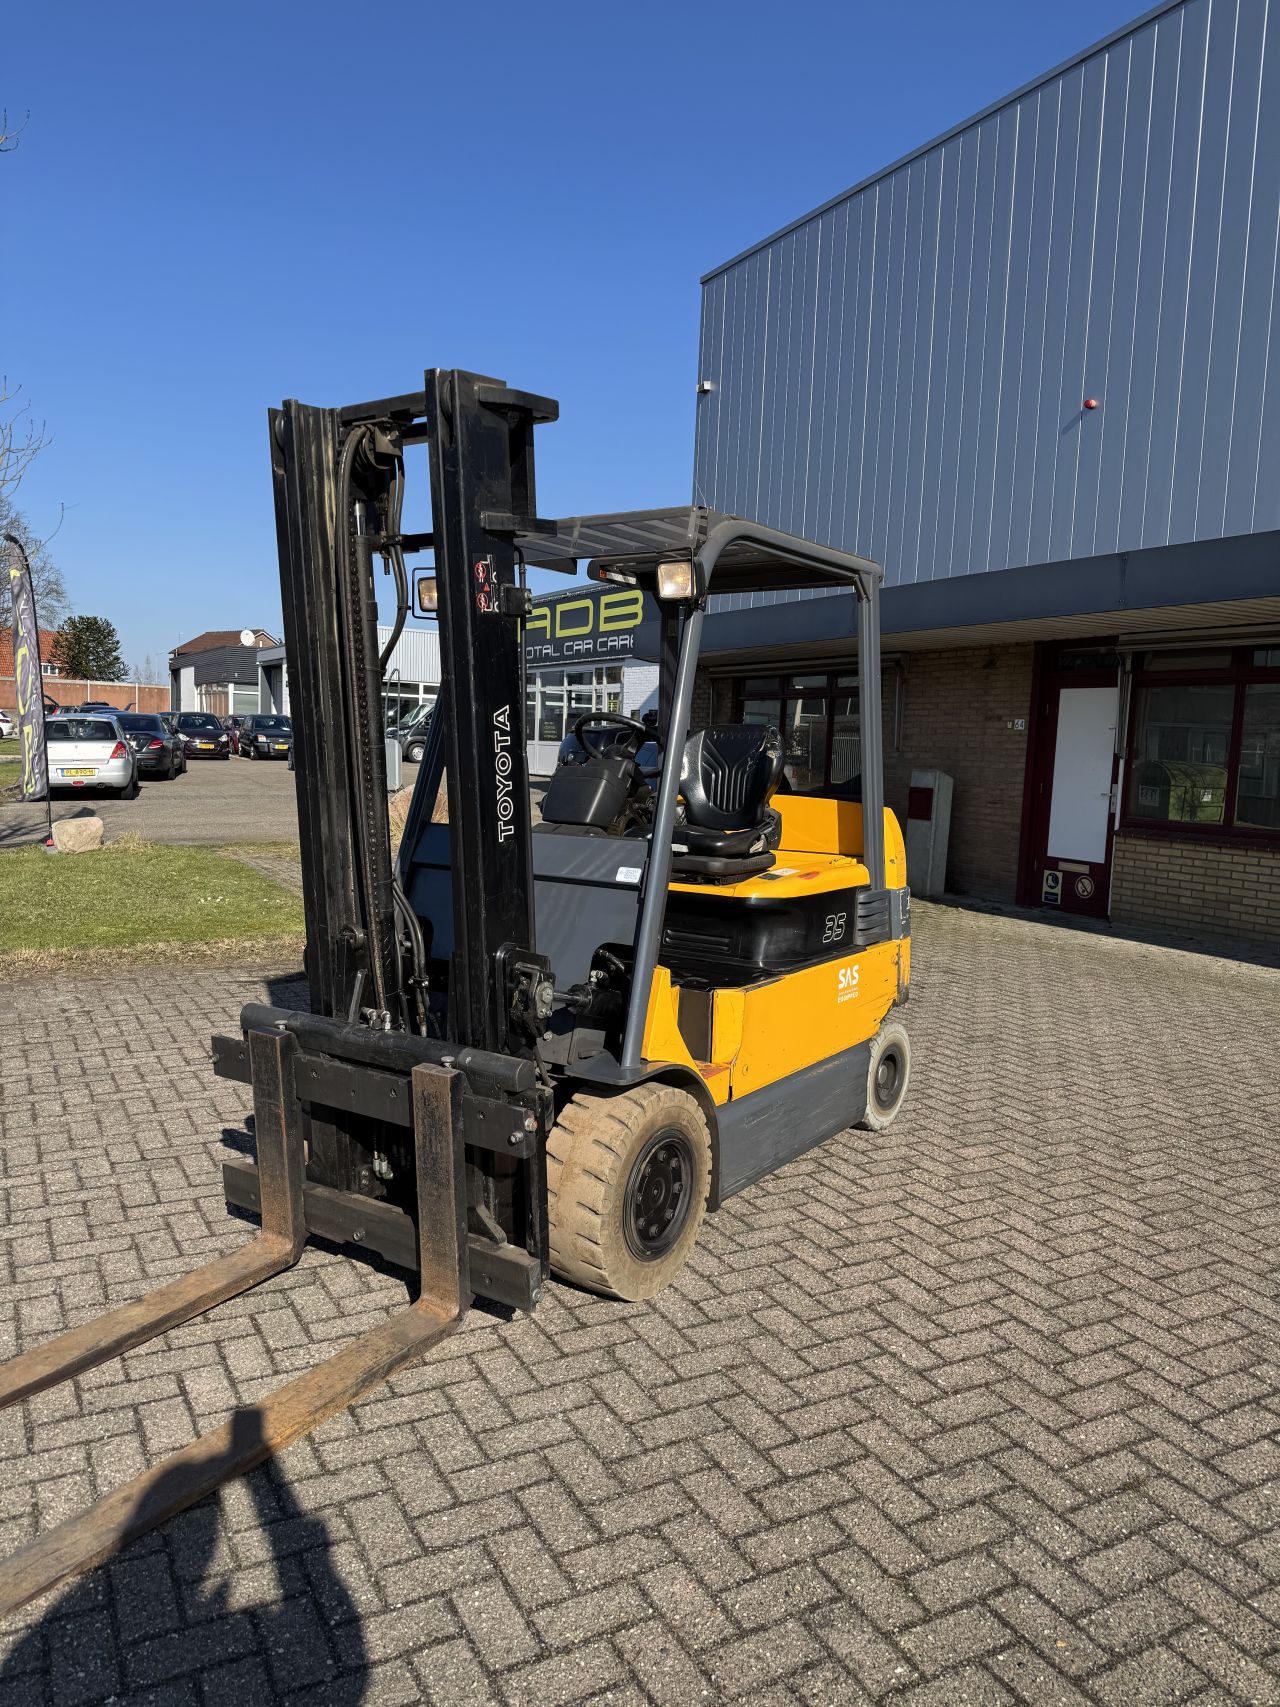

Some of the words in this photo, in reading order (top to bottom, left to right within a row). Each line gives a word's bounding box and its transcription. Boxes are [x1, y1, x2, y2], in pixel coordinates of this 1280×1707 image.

[525, 644, 560, 659] OTAL
[564, 640, 593, 655] CAR
[493, 705, 514, 842] TOYOTA
[823, 912, 847, 943] 35
[838, 964, 859, 990] SAS
